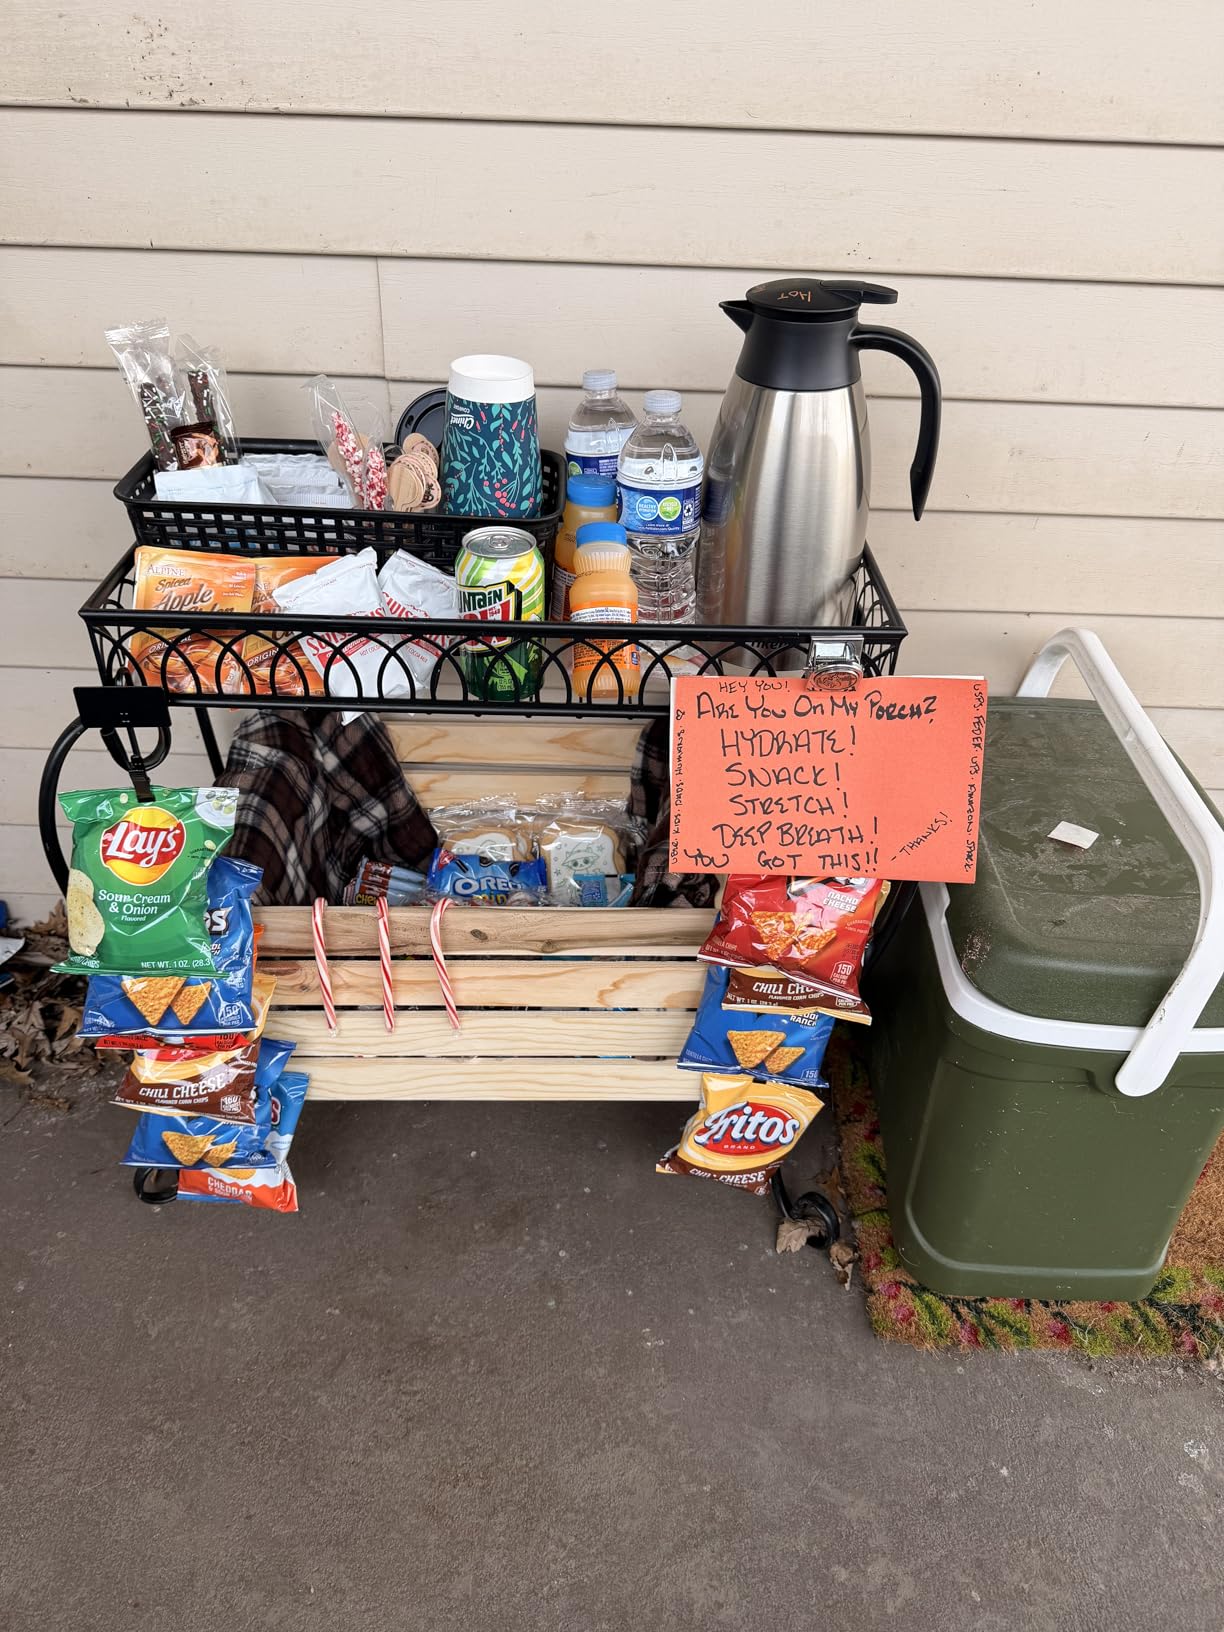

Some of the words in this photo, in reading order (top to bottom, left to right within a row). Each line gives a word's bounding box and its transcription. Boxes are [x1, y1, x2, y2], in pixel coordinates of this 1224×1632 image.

[777, 290, 812, 302] HOT
[147, 564, 186, 577] ALPINE
[154, 577, 192, 594] Spiced
[153, 583, 214, 611] Apple
[719, 680, 748, 693] HEY
[755, 680, 791, 693] YOU!
[721, 726, 857, 757] HYDRATE!
[725, 762, 842, 791] SNACK!
[729, 792, 849, 819] STRETCH!
[712, 821, 773, 849] DEEP
[777, 817, 879, 847] BREATH!
[899, 811, 953, 857] THANKS!
[106, 821, 181, 868] Lay's
[684, 848, 730, 869] YOU
[757, 852, 803, 870] GOT
[818, 848, 879, 873] THIS!!
[98, 889, 132, 904] Sour
[133, 892, 171, 904] Cream
[828, 891, 859, 905] NACHO
[108, 902, 120, 914] &
[122, 903, 158, 915] Onion
[823, 898, 857, 913] CHEESE
[141, 961, 156, 969] NET
[157, 960, 172, 969] WT.
[178, 960, 191, 968] OZ.
[838, 963, 852, 975] 150
[752, 982, 783, 995] CHILI
[139, 1087, 169, 1099] CHILI
[173, 1073, 226, 1099] CHEESE
[693, 1101, 800, 1145] Fritos
